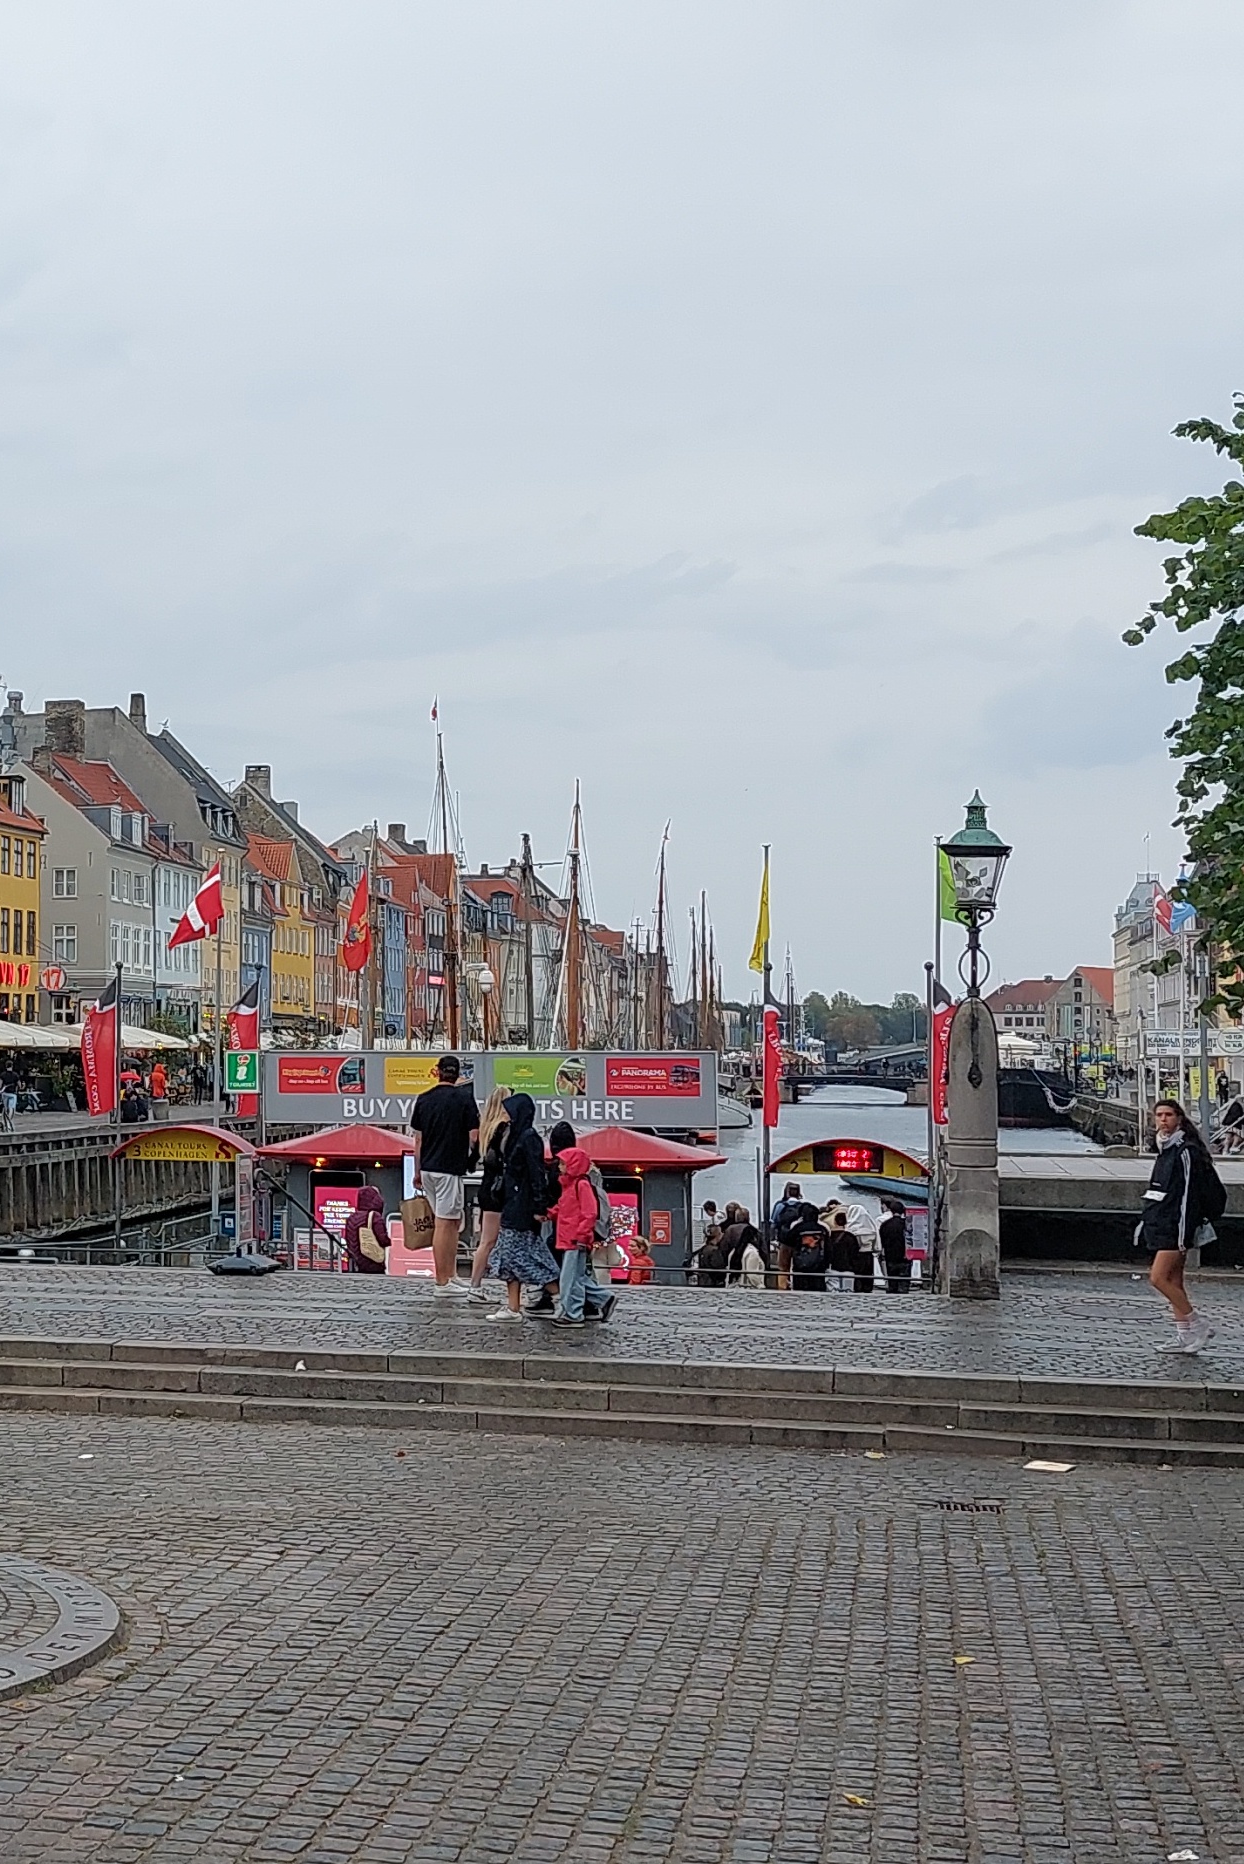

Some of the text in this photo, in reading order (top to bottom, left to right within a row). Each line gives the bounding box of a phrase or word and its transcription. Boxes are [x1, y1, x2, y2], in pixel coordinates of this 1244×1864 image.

[17, 963, 31, 987] 17
[42, 968, 62, 991] 17
[621, 1069, 667, 1077] PANORAMA
[342, 1098, 391, 1119] BUY
[571, 1100, 635, 1121] HERE
[132, 1144, 141, 1157] 3
[143, 1150, 208, 1159] COPENHAGEN
[144, 1142, 208, 1150] CANAL TOURS
[790, 1161, 799, 1173] 2
[898, 1163, 906, 1177] 1
[19, 1567, 105, 1626] MISTEDE
[24, 1632, 96, 1663] DER
